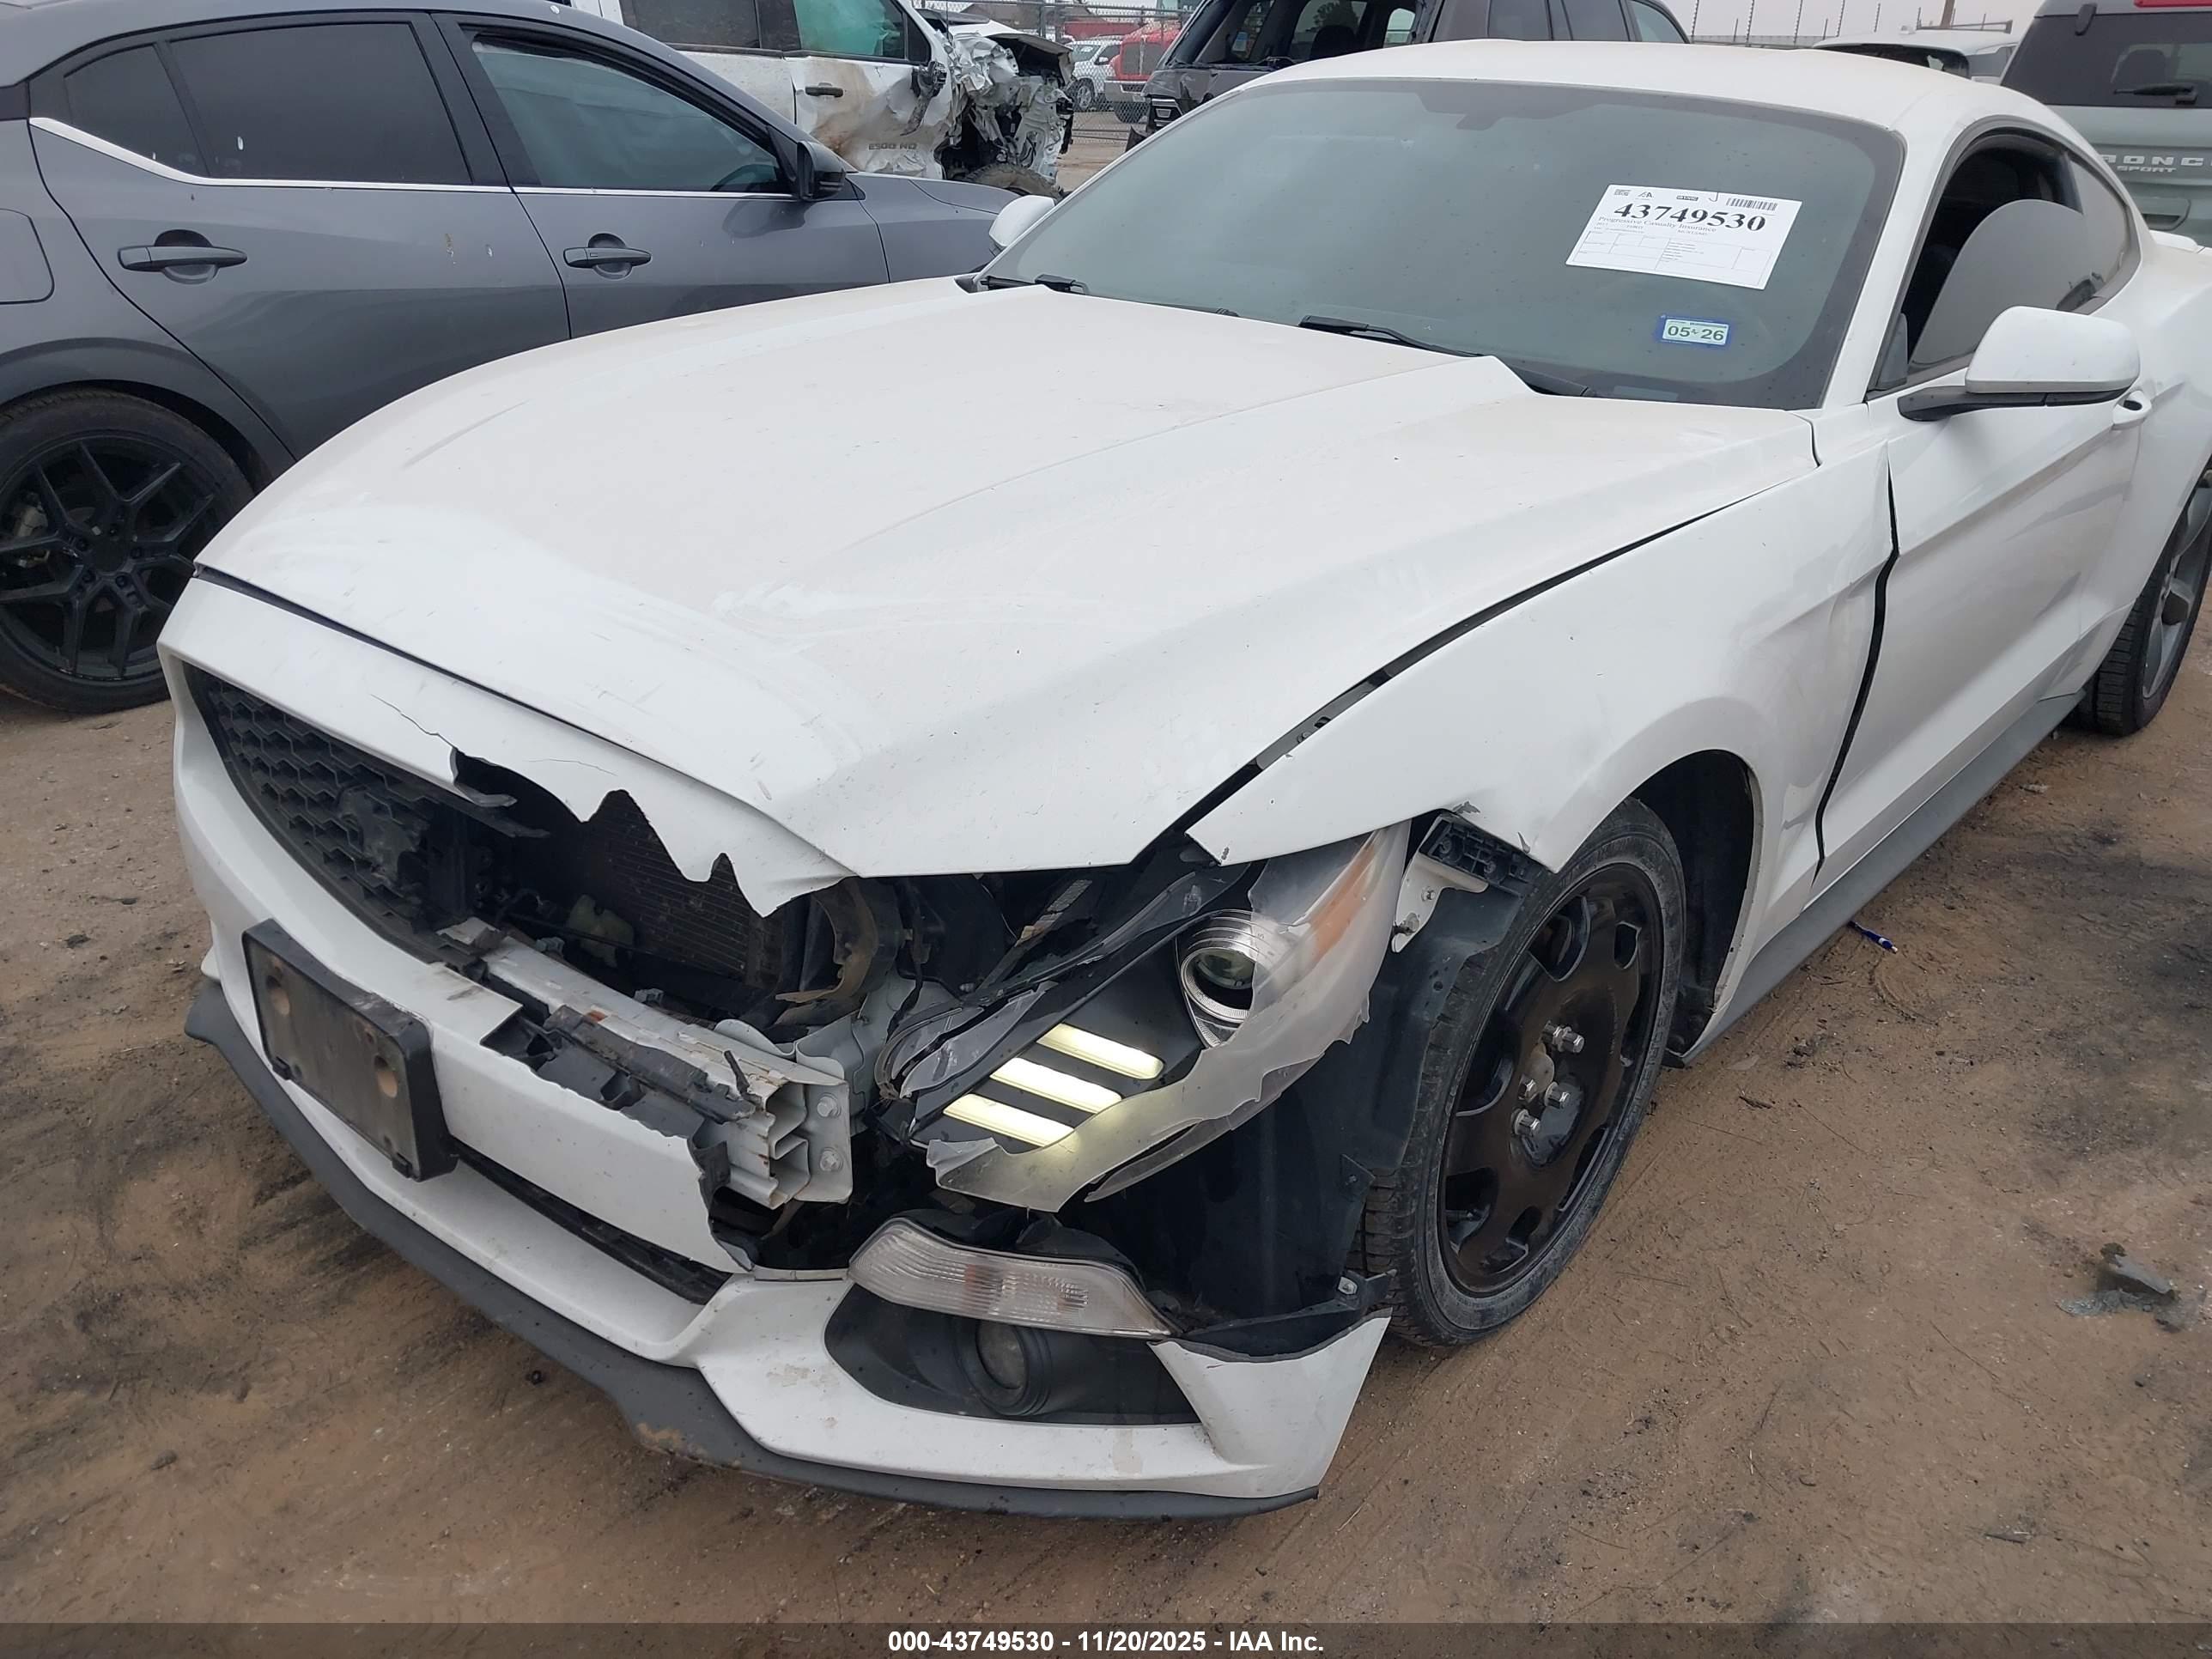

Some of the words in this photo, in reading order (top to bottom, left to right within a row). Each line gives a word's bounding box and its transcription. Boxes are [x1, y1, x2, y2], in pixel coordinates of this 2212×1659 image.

[2098, 155, 2212, 167] RONC
[1598, 216, 1644, 226] Progressive
[1644, 220, 1676, 228] Casualty
[1678, 223, 1717, 233] Insurance
[1613, 203, 1766, 232] 43749530
[1668, 325, 1691, 337] 05
[1700, 329, 1725, 341] 26
